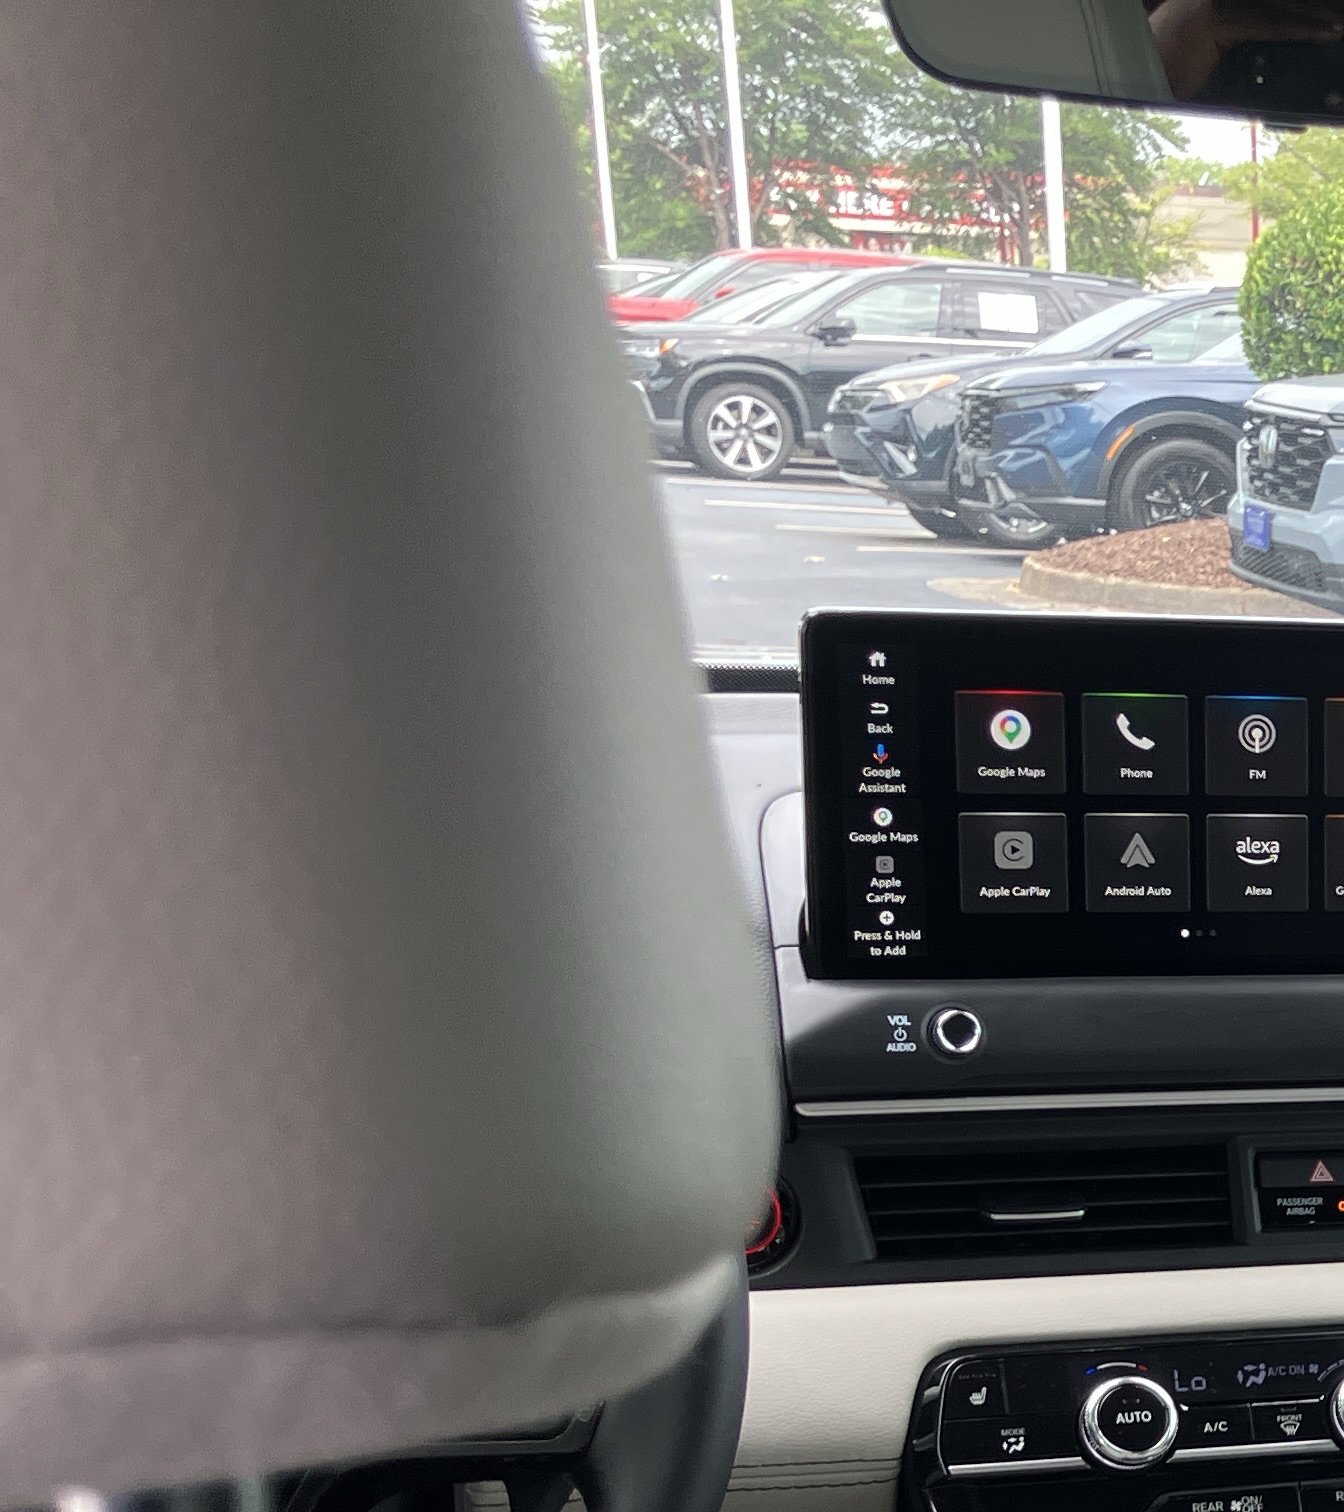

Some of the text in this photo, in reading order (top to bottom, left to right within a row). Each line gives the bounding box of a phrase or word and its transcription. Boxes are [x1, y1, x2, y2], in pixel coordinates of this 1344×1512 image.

[862, 675, 895, 685] Home
[867, 723, 894, 734] Back
[862, 767, 901, 779] Google
[978, 766, 1046, 779] Google Maps
[1120, 768, 1153, 778] Phone
[1249, 769, 1266, 780] FM
[859, 783, 907, 793] Assistant
[849, 832, 919, 844] Google Maps
[1235, 837, 1280, 854] alexa
[870, 877, 902, 889] Apple
[979, 885, 1051, 899] Apple CarPlay
[1104, 885, 1171, 896] Android Auto
[1245, 885, 1272, 896] Alexa
[866, 893, 907, 904] CarPlay
[854, 930, 921, 941] Press & Hold
[870, 946, 906, 956] to Add
[887, 1015, 911, 1026] VOL
[886, 1042, 916, 1052] AUDIO
[1277, 1197, 1323, 1207] PASSENGER
[1286, 1207, 1315, 1216] AIRBAG
[1267, 1365, 1305, 1377] A/C ON
[1116, 1410, 1152, 1425] AUTO
[1277, 1414, 1302, 1422] FRONT
[1001, 1428, 1025, 1437] MODE
[1204, 1421, 1228, 1433] A/C
[1241, 1495, 1263, 1504] ON/
